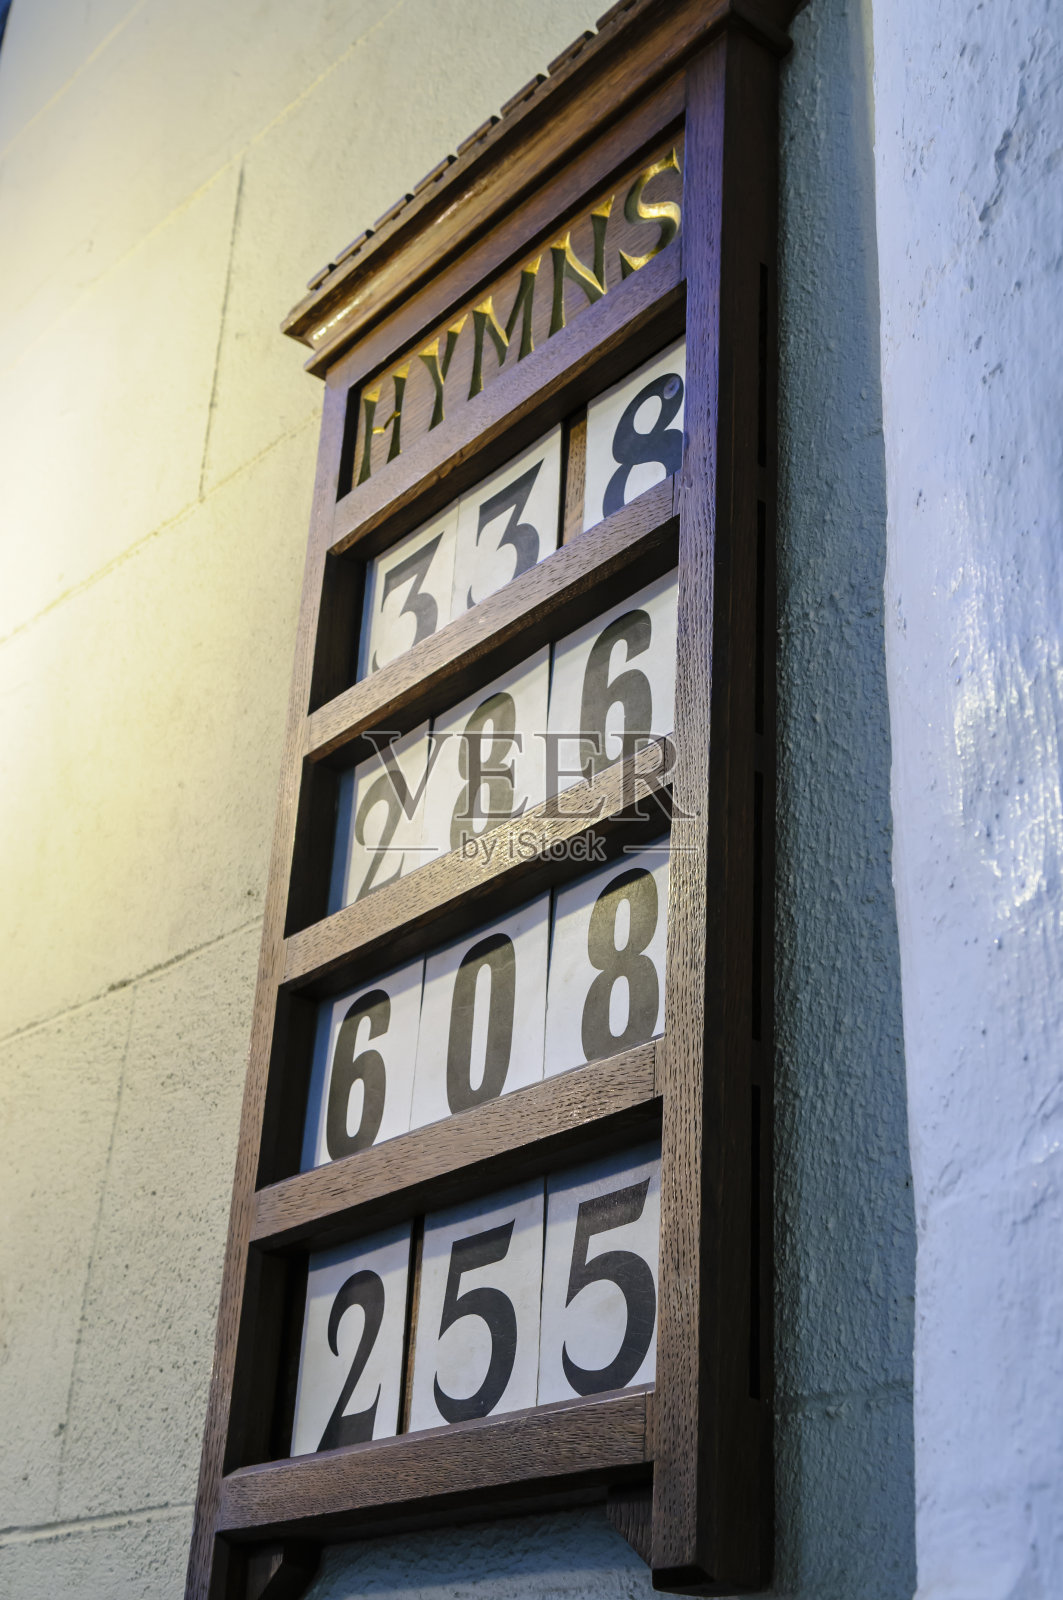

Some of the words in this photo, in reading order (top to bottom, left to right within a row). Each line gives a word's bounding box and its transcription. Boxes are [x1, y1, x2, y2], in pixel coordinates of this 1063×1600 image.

[357, 147, 682, 486] HYMNS
[372, 372, 684, 672] 338
[355, 609, 652, 902] 286
[326, 867, 660, 1161] 608
[316, 1177, 657, 1452] 255
